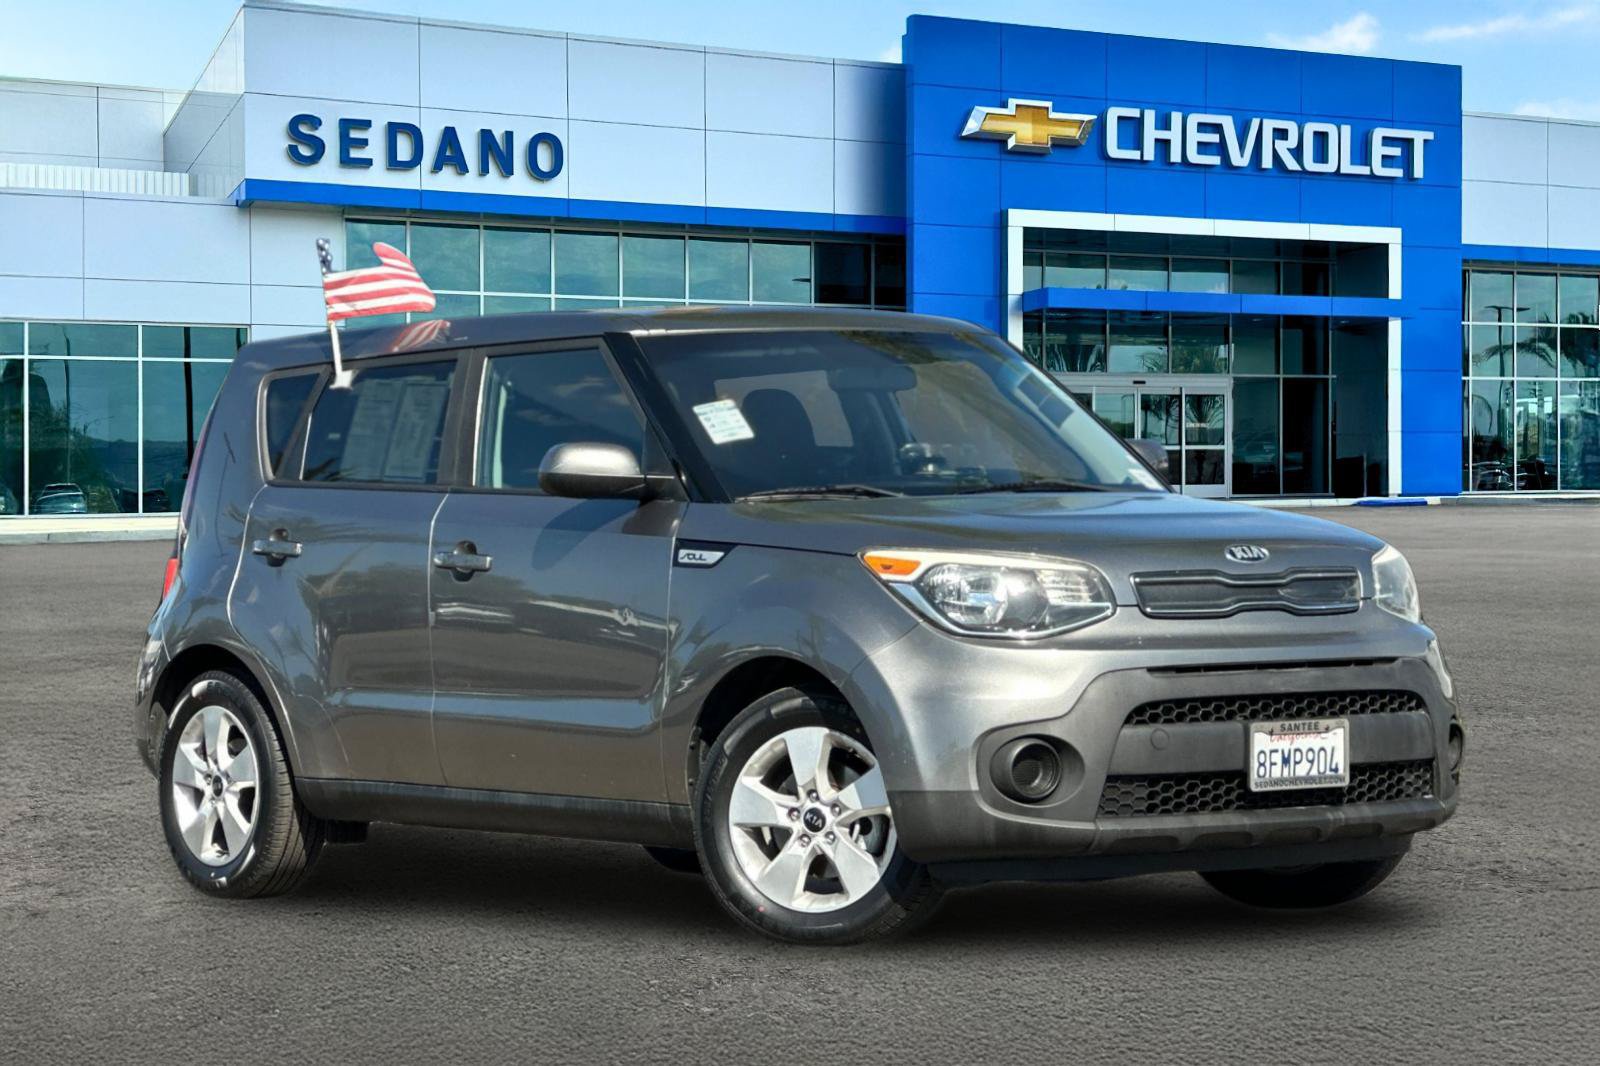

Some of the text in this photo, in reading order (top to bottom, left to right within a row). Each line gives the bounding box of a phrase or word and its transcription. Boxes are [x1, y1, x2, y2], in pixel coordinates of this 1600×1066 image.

[286, 113, 564, 183] SEDANO
[1106, 106, 1435, 179] CHEVROLET
[1229, 545, 1266, 561] KIA
[1279, 721, 1320, 733] SANTEE
[1256, 746, 1339, 779] 8FMP904
[805, 812, 823, 829] KIA
